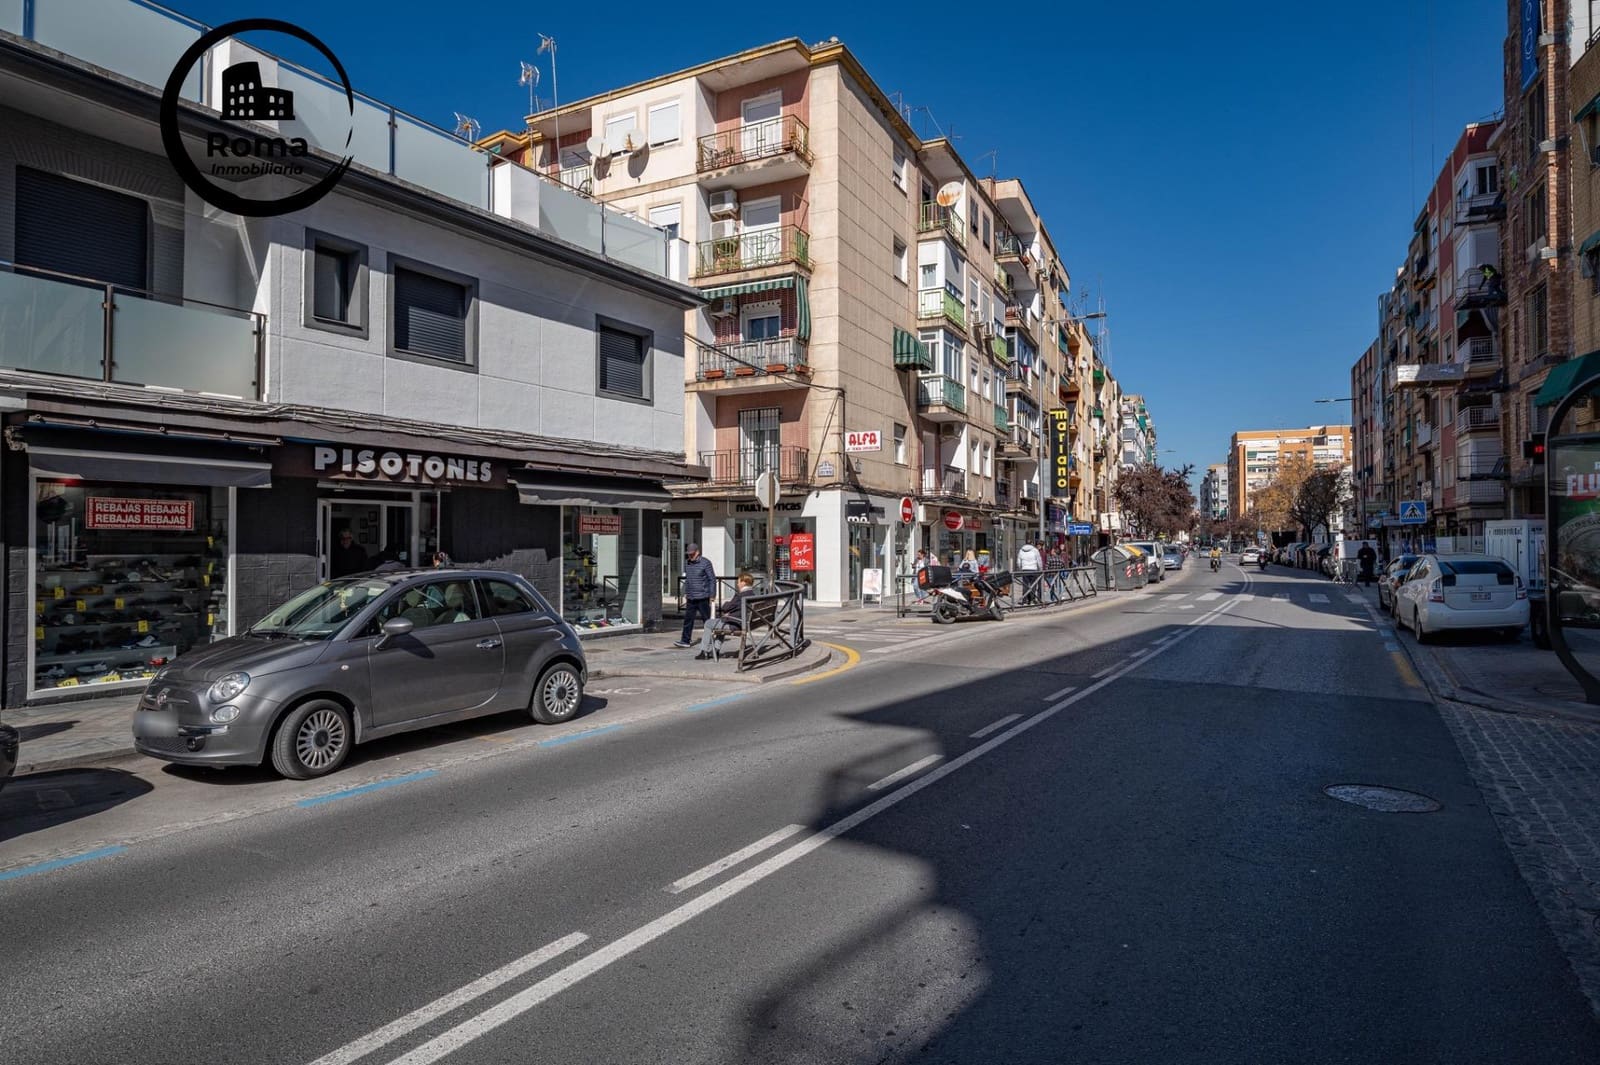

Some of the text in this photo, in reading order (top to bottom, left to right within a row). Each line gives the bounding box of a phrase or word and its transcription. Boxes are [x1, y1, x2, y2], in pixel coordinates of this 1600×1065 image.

[848, 432, 877, 446] ALFA
[1050, 409, 1067, 487] mariano
[314, 446, 492, 482] PISOTONES
[95, 502, 141, 513] REBAJAS
[143, 504, 186, 515] REBAJAS
[95, 513, 141, 524] REBAJAS
[143, 515, 186, 525] REBAJAS
